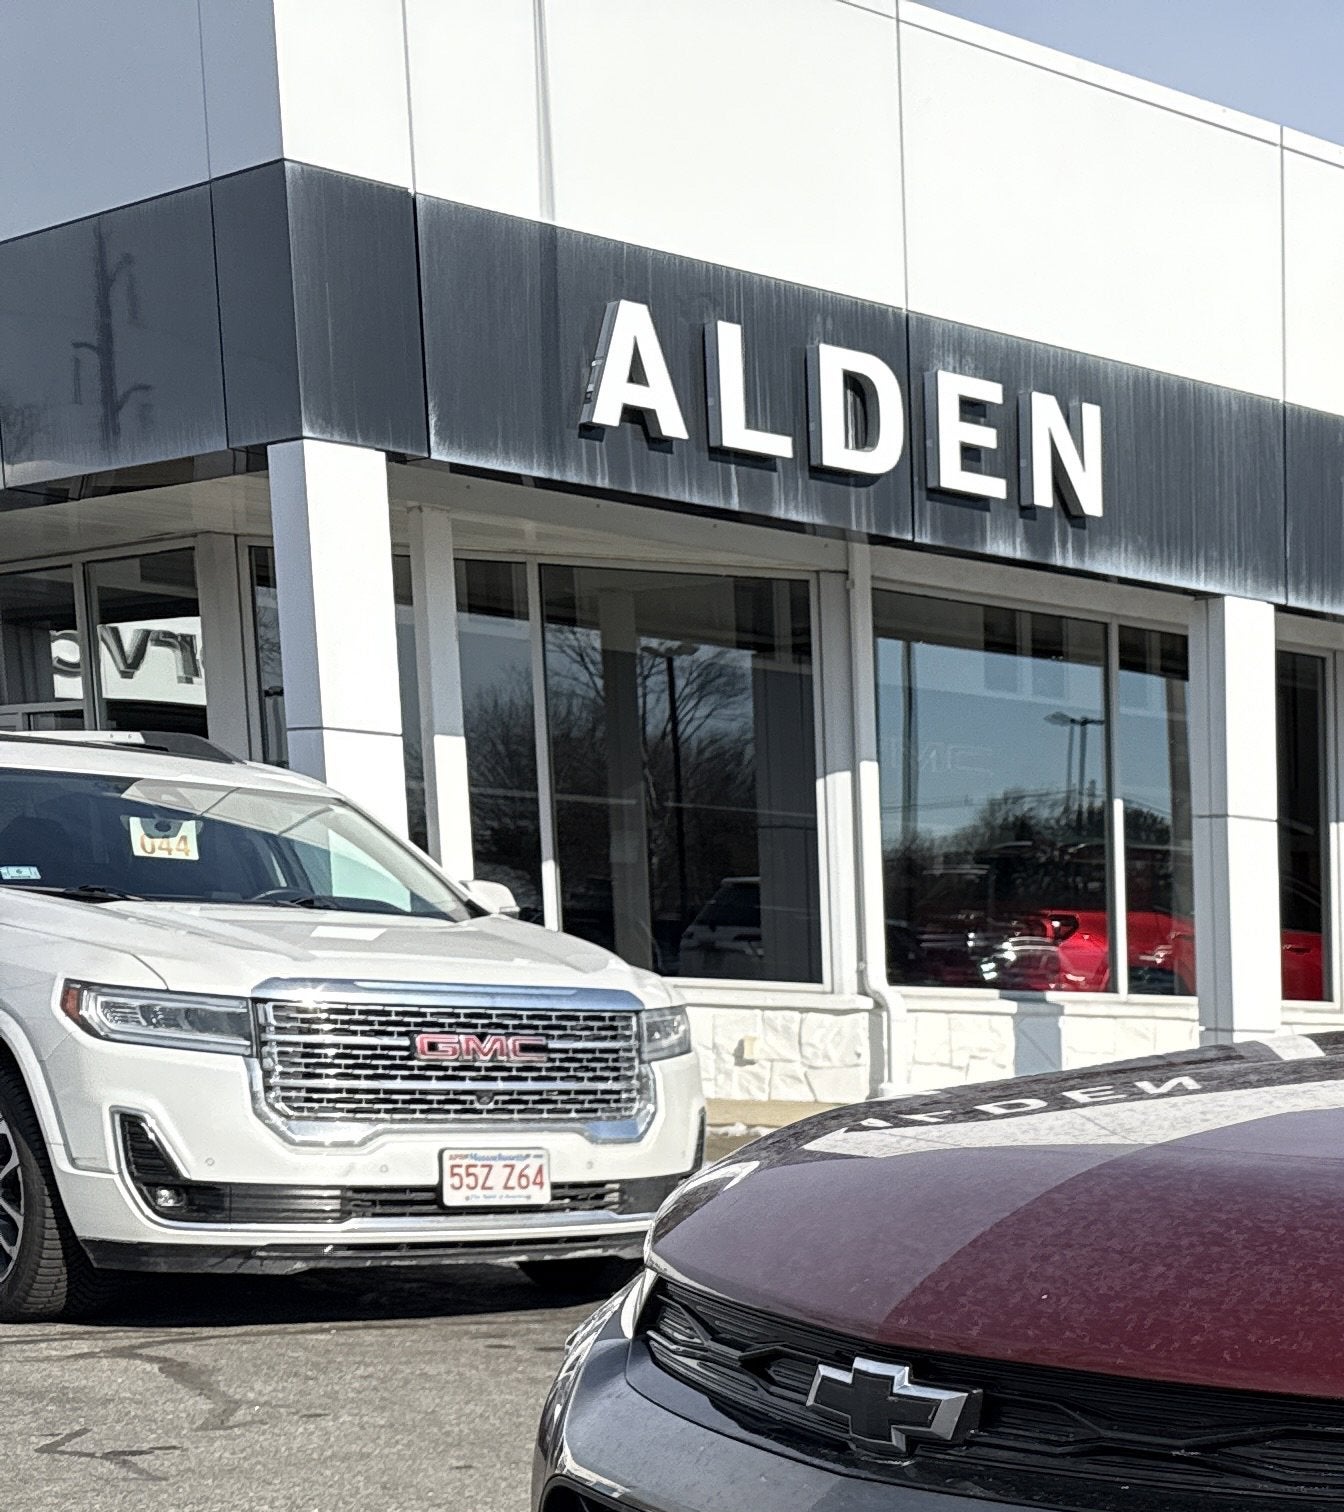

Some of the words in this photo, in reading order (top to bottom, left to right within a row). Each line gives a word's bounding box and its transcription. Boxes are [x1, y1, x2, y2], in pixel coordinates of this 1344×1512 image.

[584, 298, 1102, 518] ALDEN
[415, 1033, 547, 1062] GMC
[449, 1164, 494, 1190] 55Z
[502, 1163, 544, 1190] Z64
